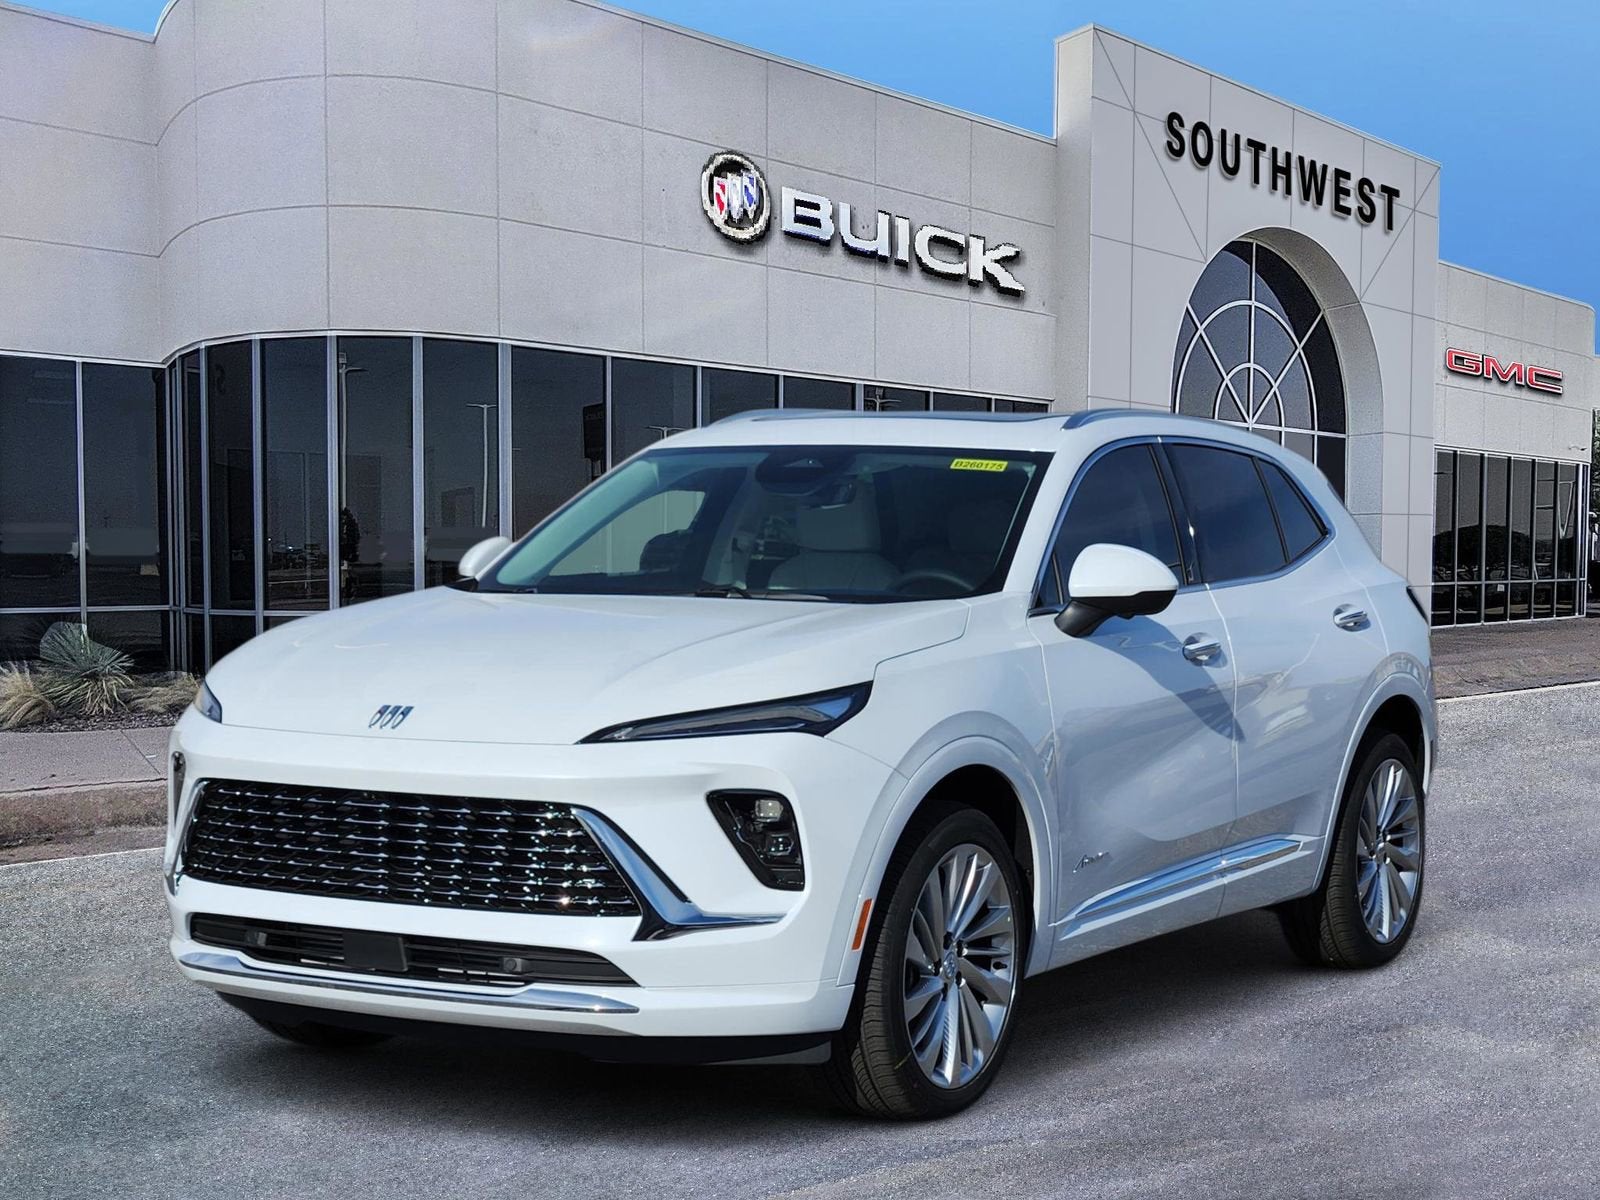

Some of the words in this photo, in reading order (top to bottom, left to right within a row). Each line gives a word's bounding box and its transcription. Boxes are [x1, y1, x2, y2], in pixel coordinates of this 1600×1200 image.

[1165, 111, 1401, 231] SOUTHWEST
[781, 186, 1025, 296] BUICK
[1446, 348, 1563, 395] GMC
[953, 460, 1005, 471] B260175
